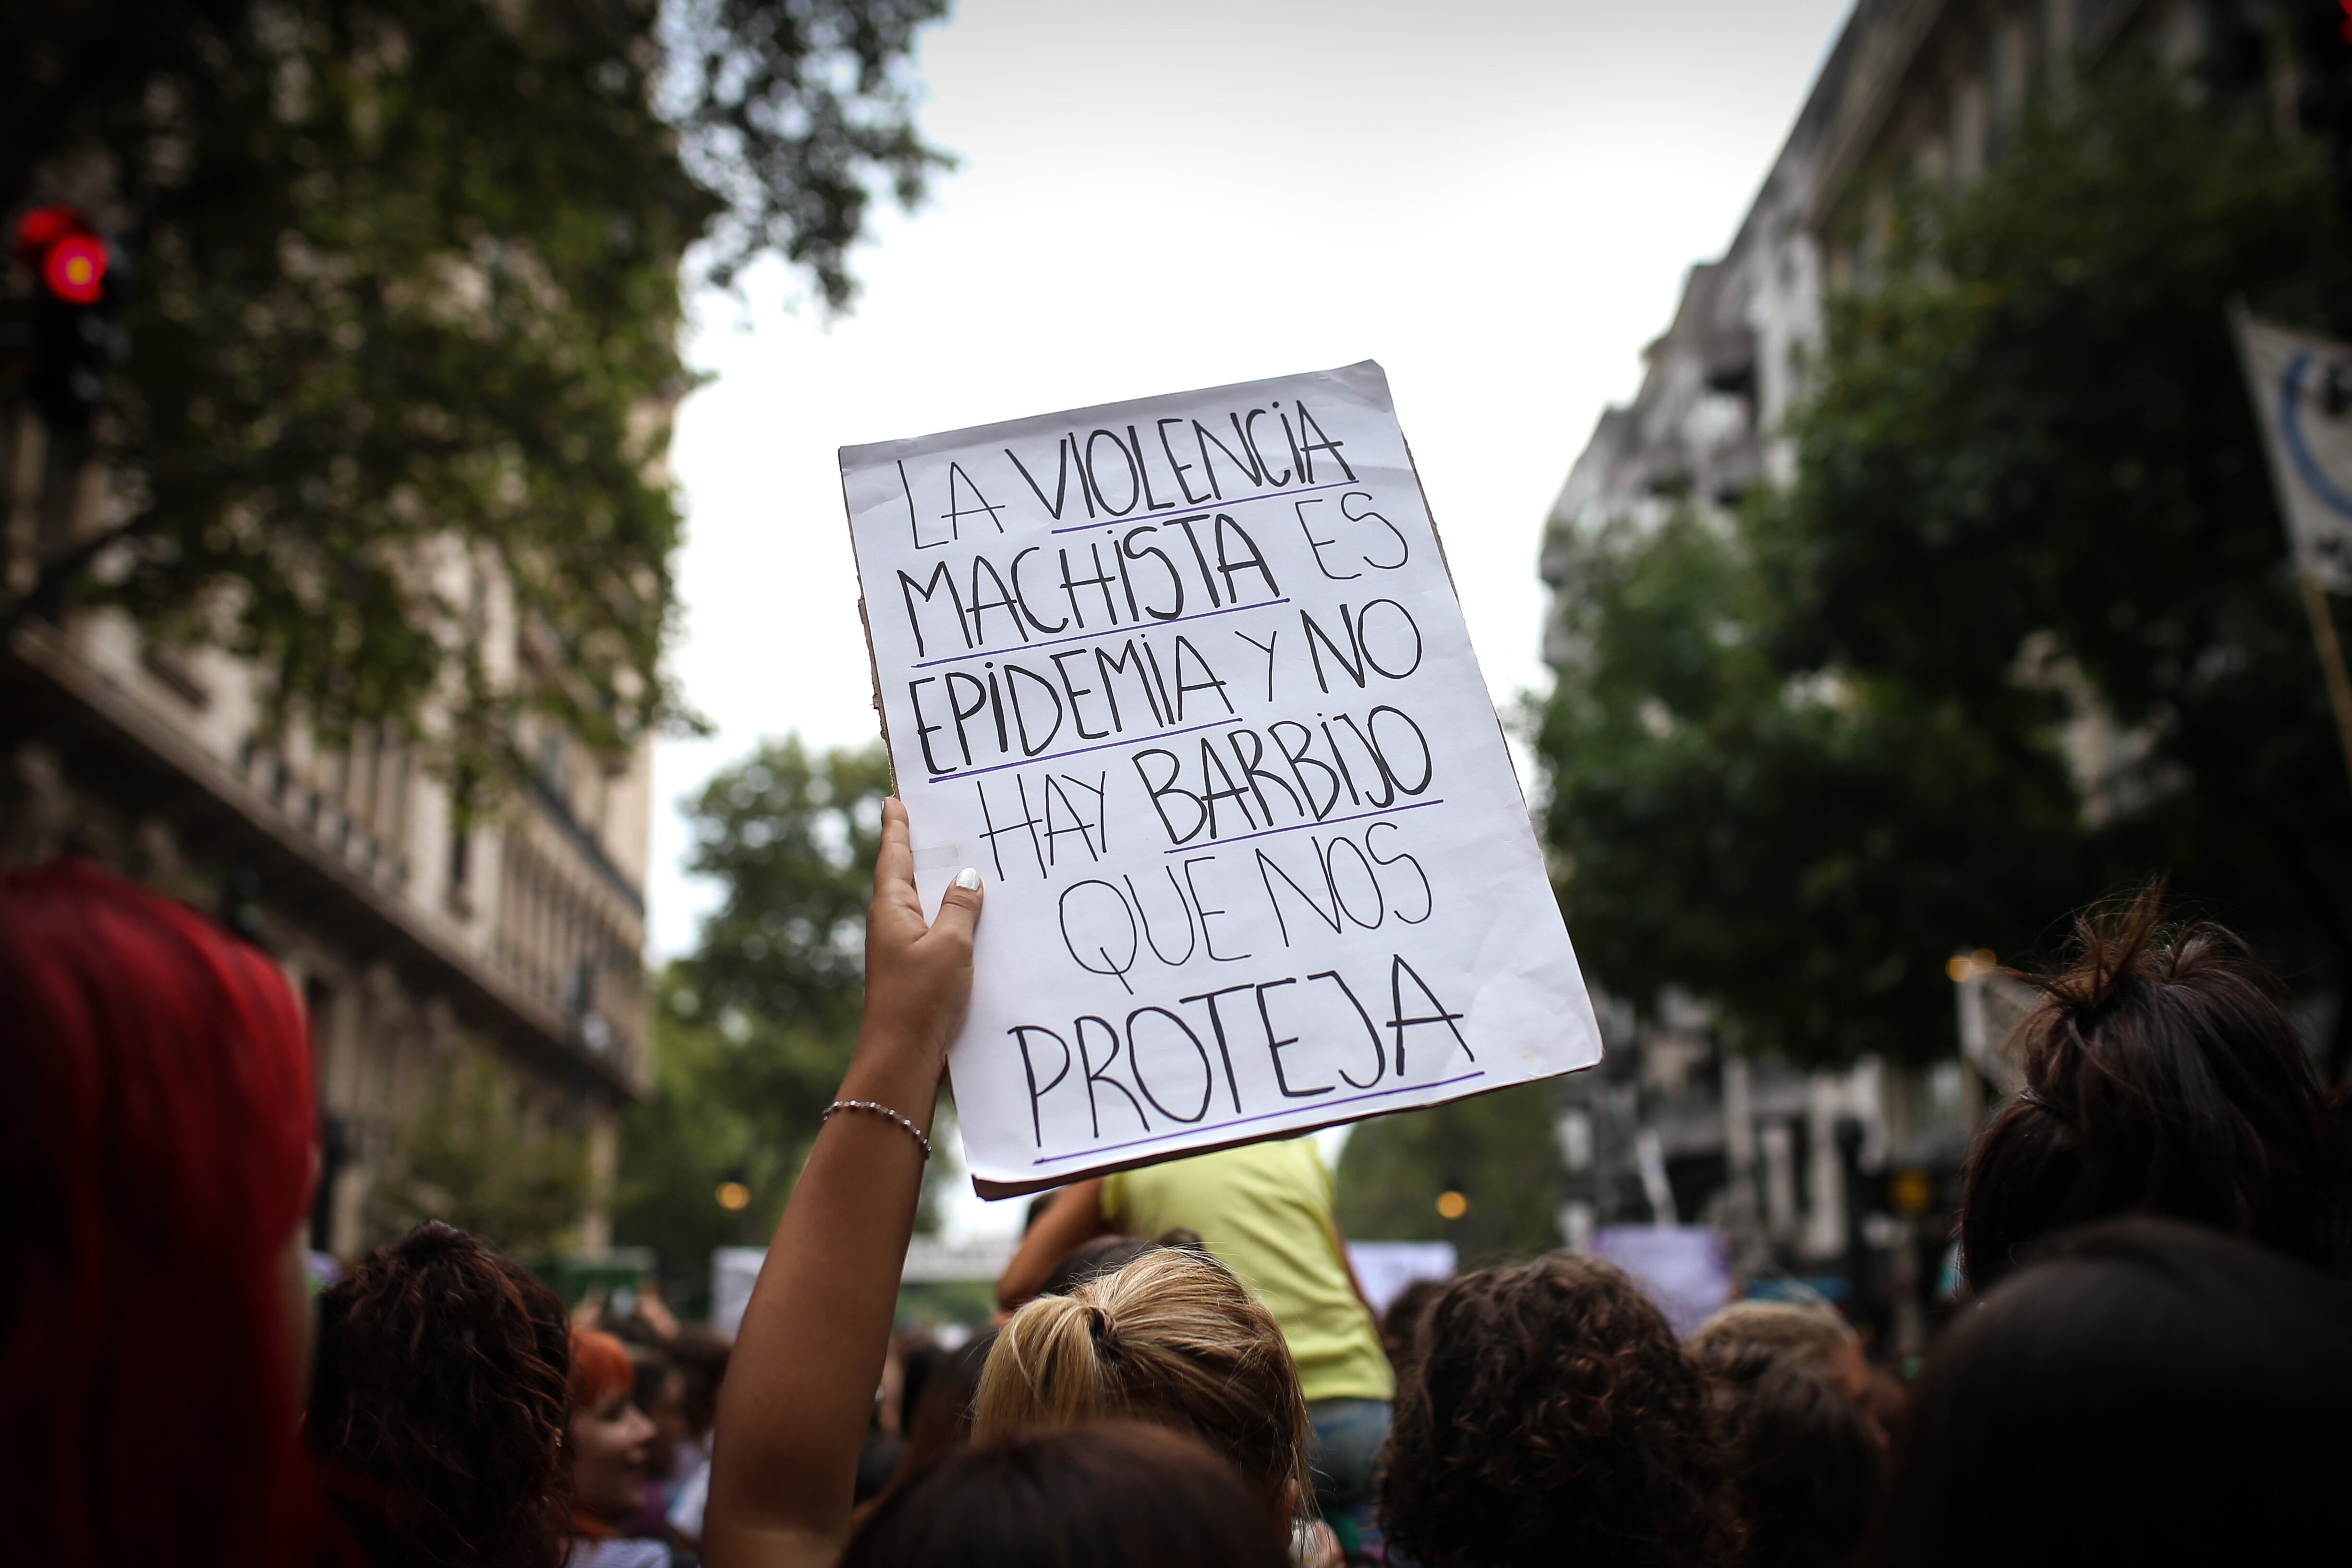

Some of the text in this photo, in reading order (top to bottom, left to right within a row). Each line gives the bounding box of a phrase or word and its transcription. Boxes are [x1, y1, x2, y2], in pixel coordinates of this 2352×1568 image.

[897, 460, 1006, 549] LA
[1295, 492, 1409, 580] ES
[1234, 630, 1277, 702] Y
[1299, 598, 1422, 694] NO
[977, 771, 1107, 882] HAY
[1058, 822, 1432, 995] QUE NOS
[1007, 954, 1475, 1147] PROTEJA
